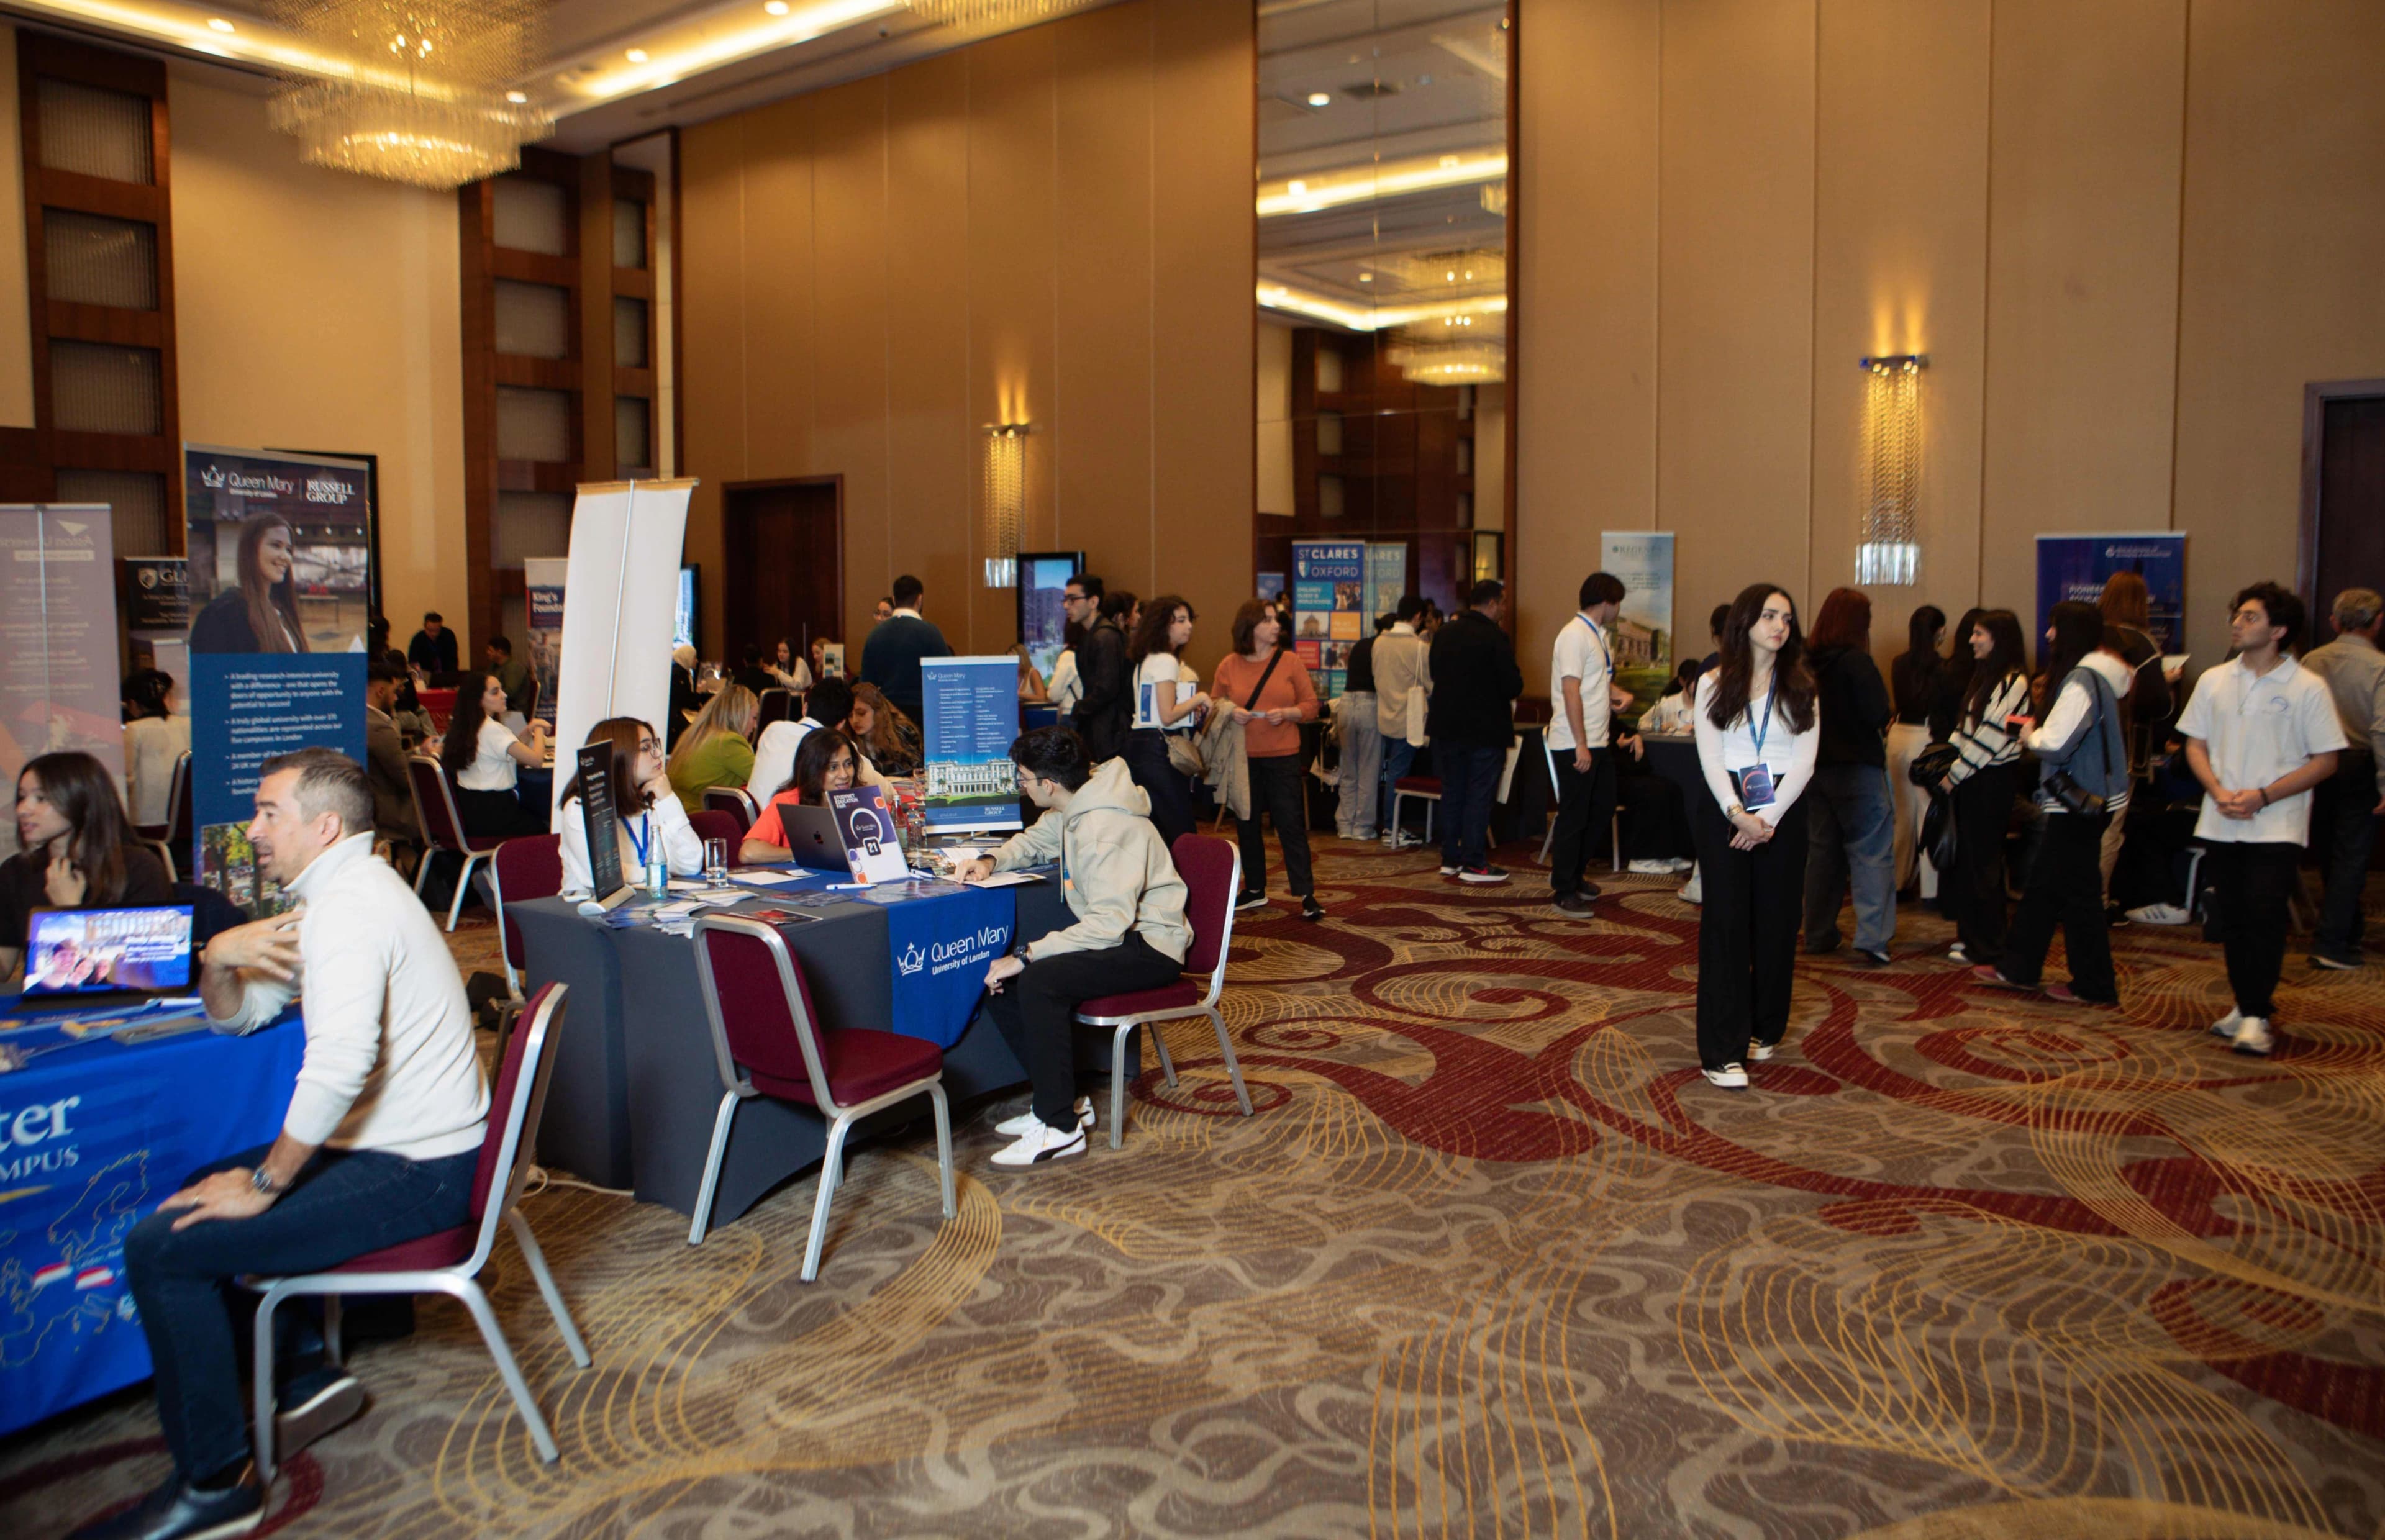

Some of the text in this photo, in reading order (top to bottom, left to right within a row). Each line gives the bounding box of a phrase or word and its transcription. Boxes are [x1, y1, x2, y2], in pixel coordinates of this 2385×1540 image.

[229, 472, 294, 494] Queen Mary
[306, 479, 355, 495] RUSSELL
[306, 491, 348, 504] GROUP
[1311, 566, 1359, 578] OXFORD
[954, 672, 965, 680] Mary
[867, 842, 878, 853] 21
[932, 925, 1009, 962] Queen Mary
[932, 951, 989, 975] University of London
